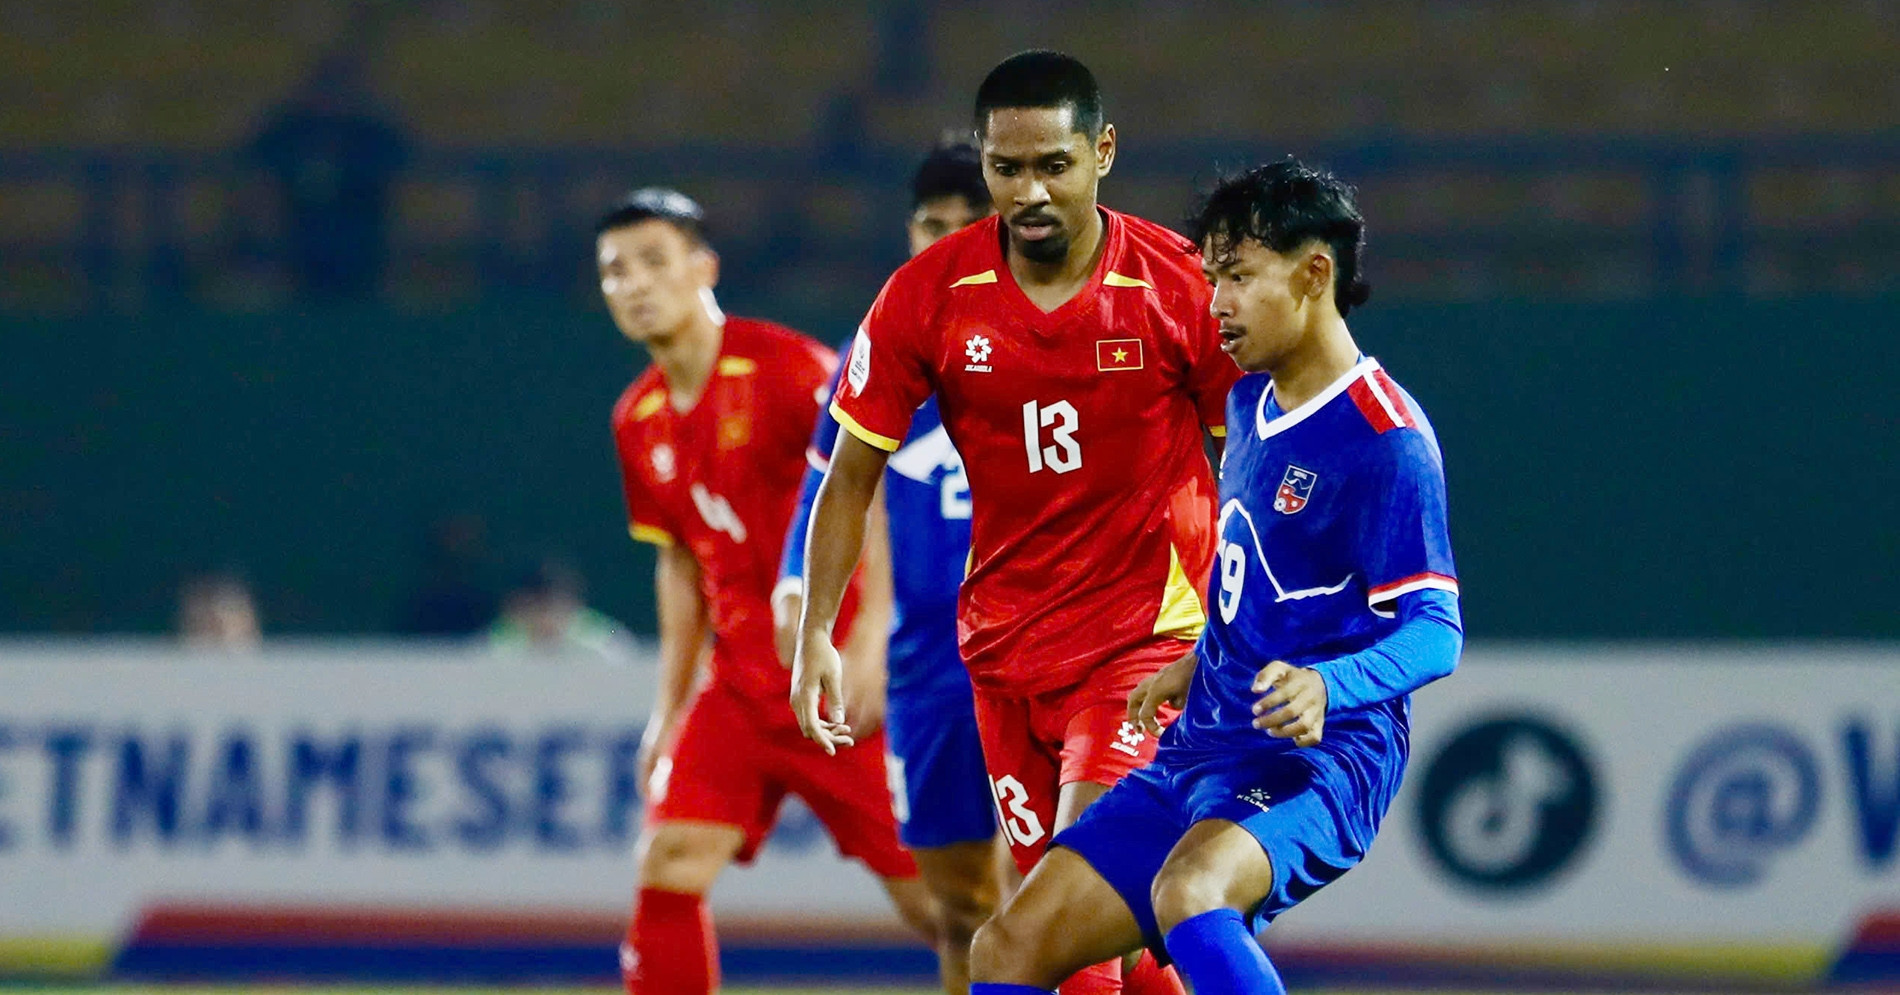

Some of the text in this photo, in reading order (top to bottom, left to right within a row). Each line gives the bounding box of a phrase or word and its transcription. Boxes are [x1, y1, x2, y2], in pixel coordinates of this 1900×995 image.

[1022, 399, 1083, 475] 13
[988, 773, 1046, 848] 13
[1236, 793, 1270, 813] KELME
